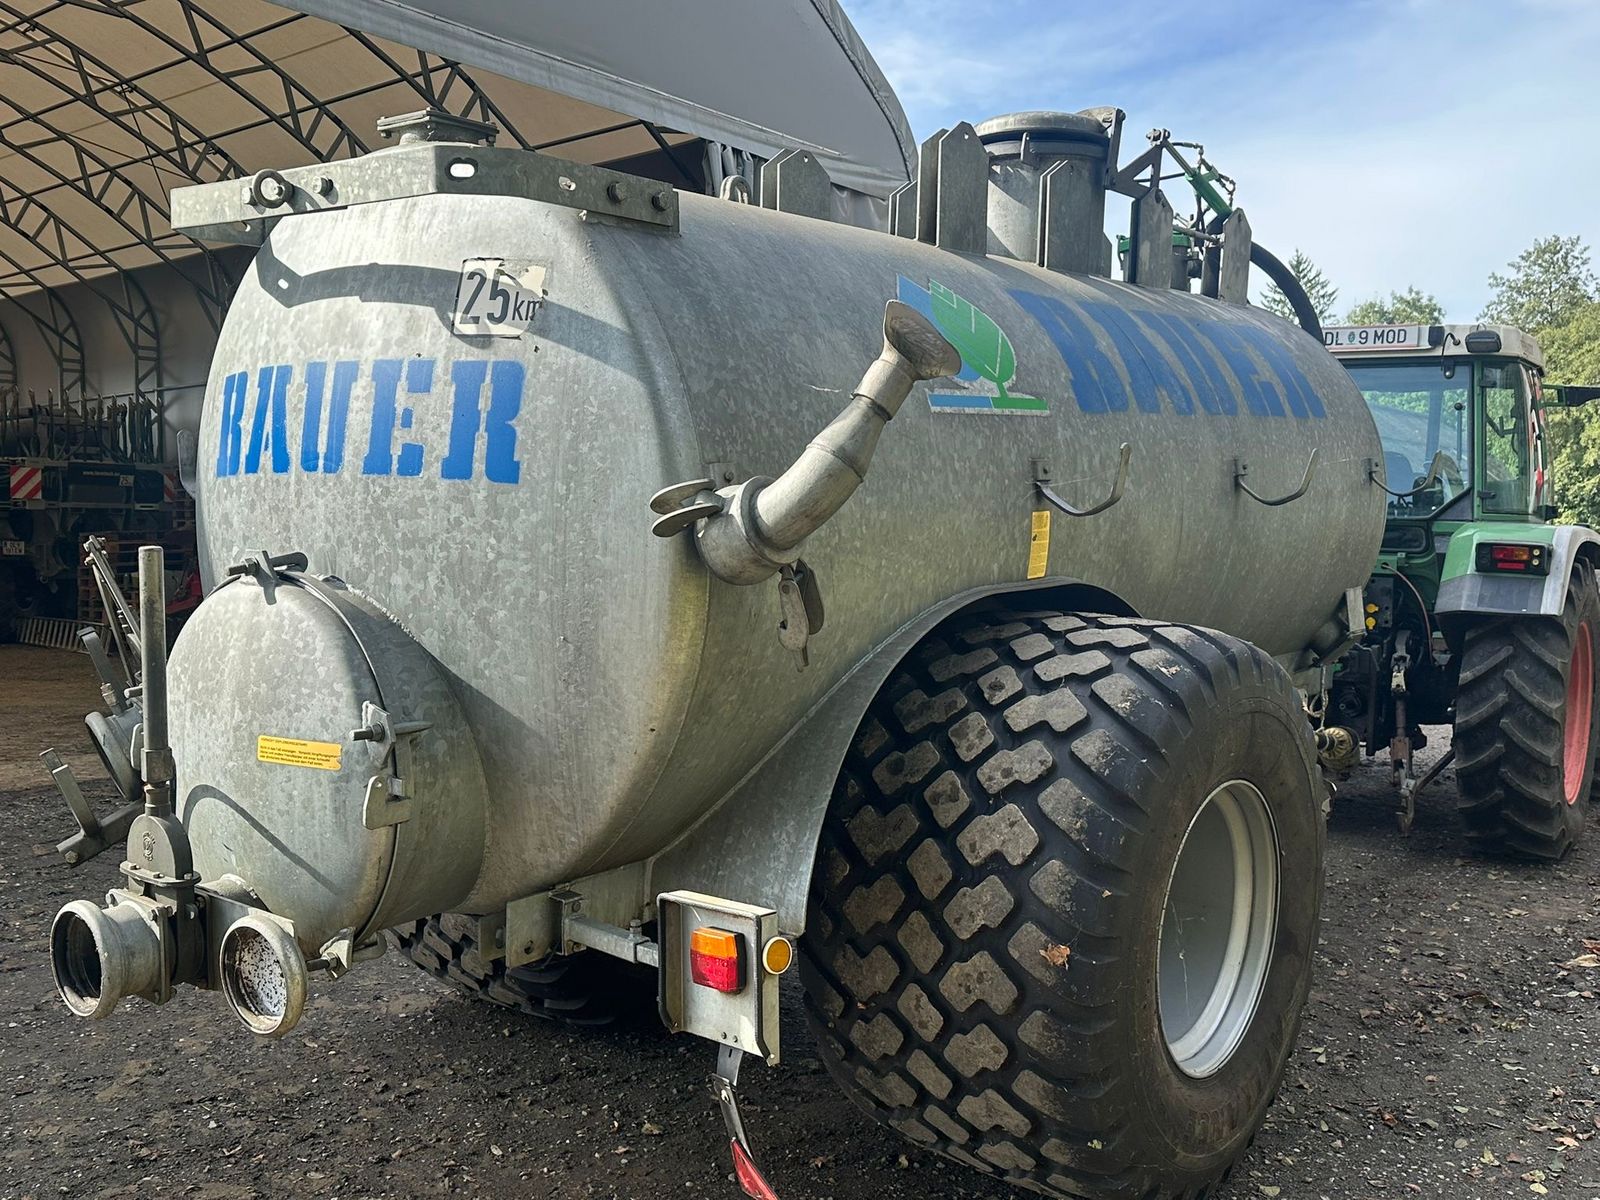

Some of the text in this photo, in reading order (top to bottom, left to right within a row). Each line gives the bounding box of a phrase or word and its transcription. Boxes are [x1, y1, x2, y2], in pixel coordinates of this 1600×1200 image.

[1007, 288, 1327, 419] BAUER
[1323, 328, 1407, 346] DL 9 MOD
[216, 359, 528, 485] BAUER
